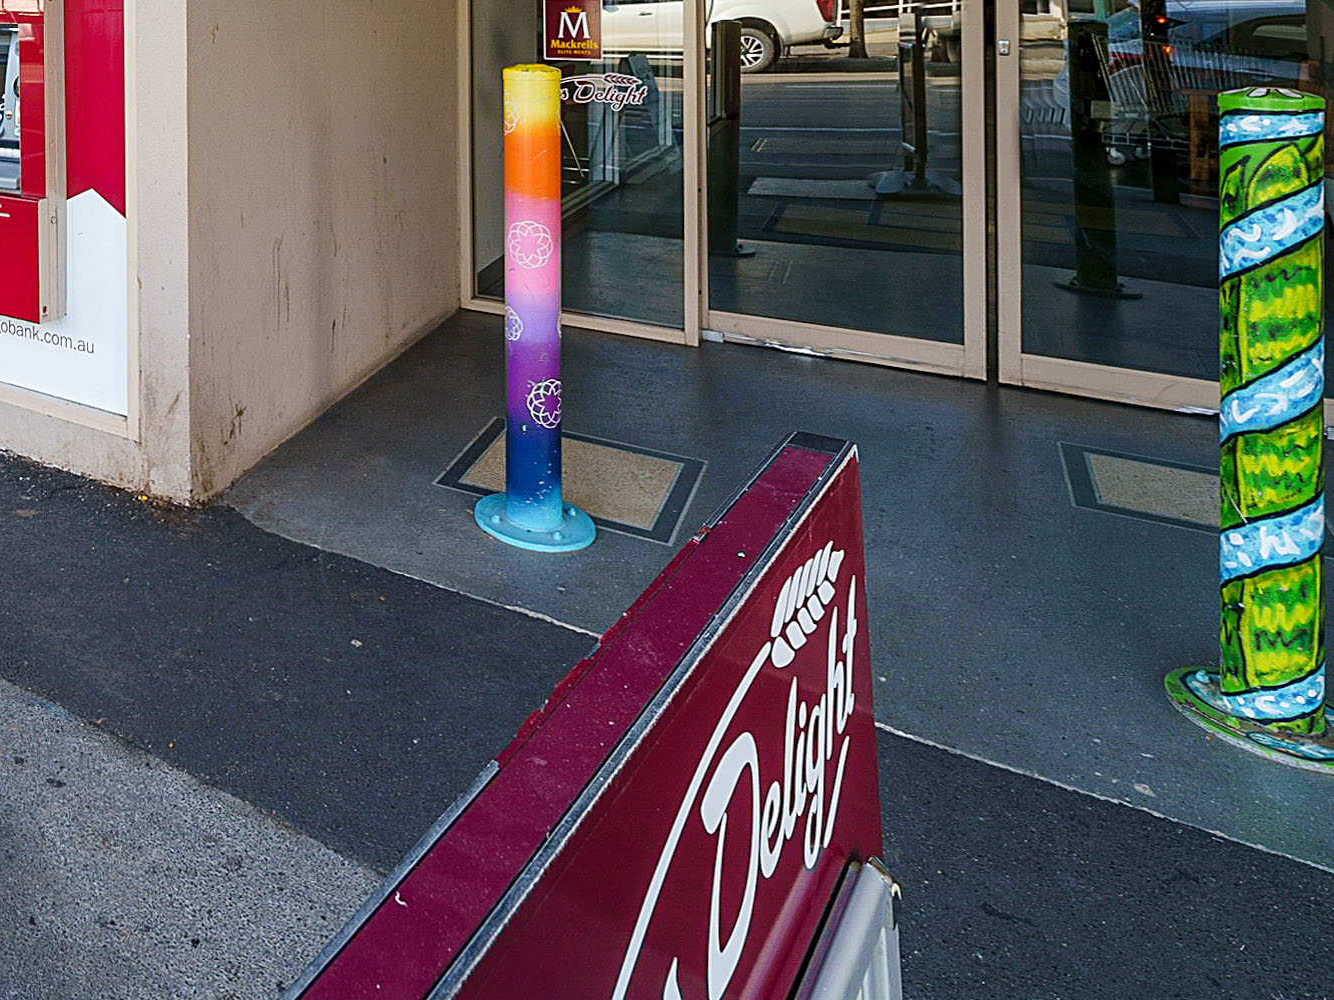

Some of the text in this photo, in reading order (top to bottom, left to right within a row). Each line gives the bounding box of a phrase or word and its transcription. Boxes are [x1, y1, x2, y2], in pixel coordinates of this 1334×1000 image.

[550, 39, 599, 50] Mackrells
[573, 79, 648, 111] Delight
[700, 574, 858, 1000] Delight
